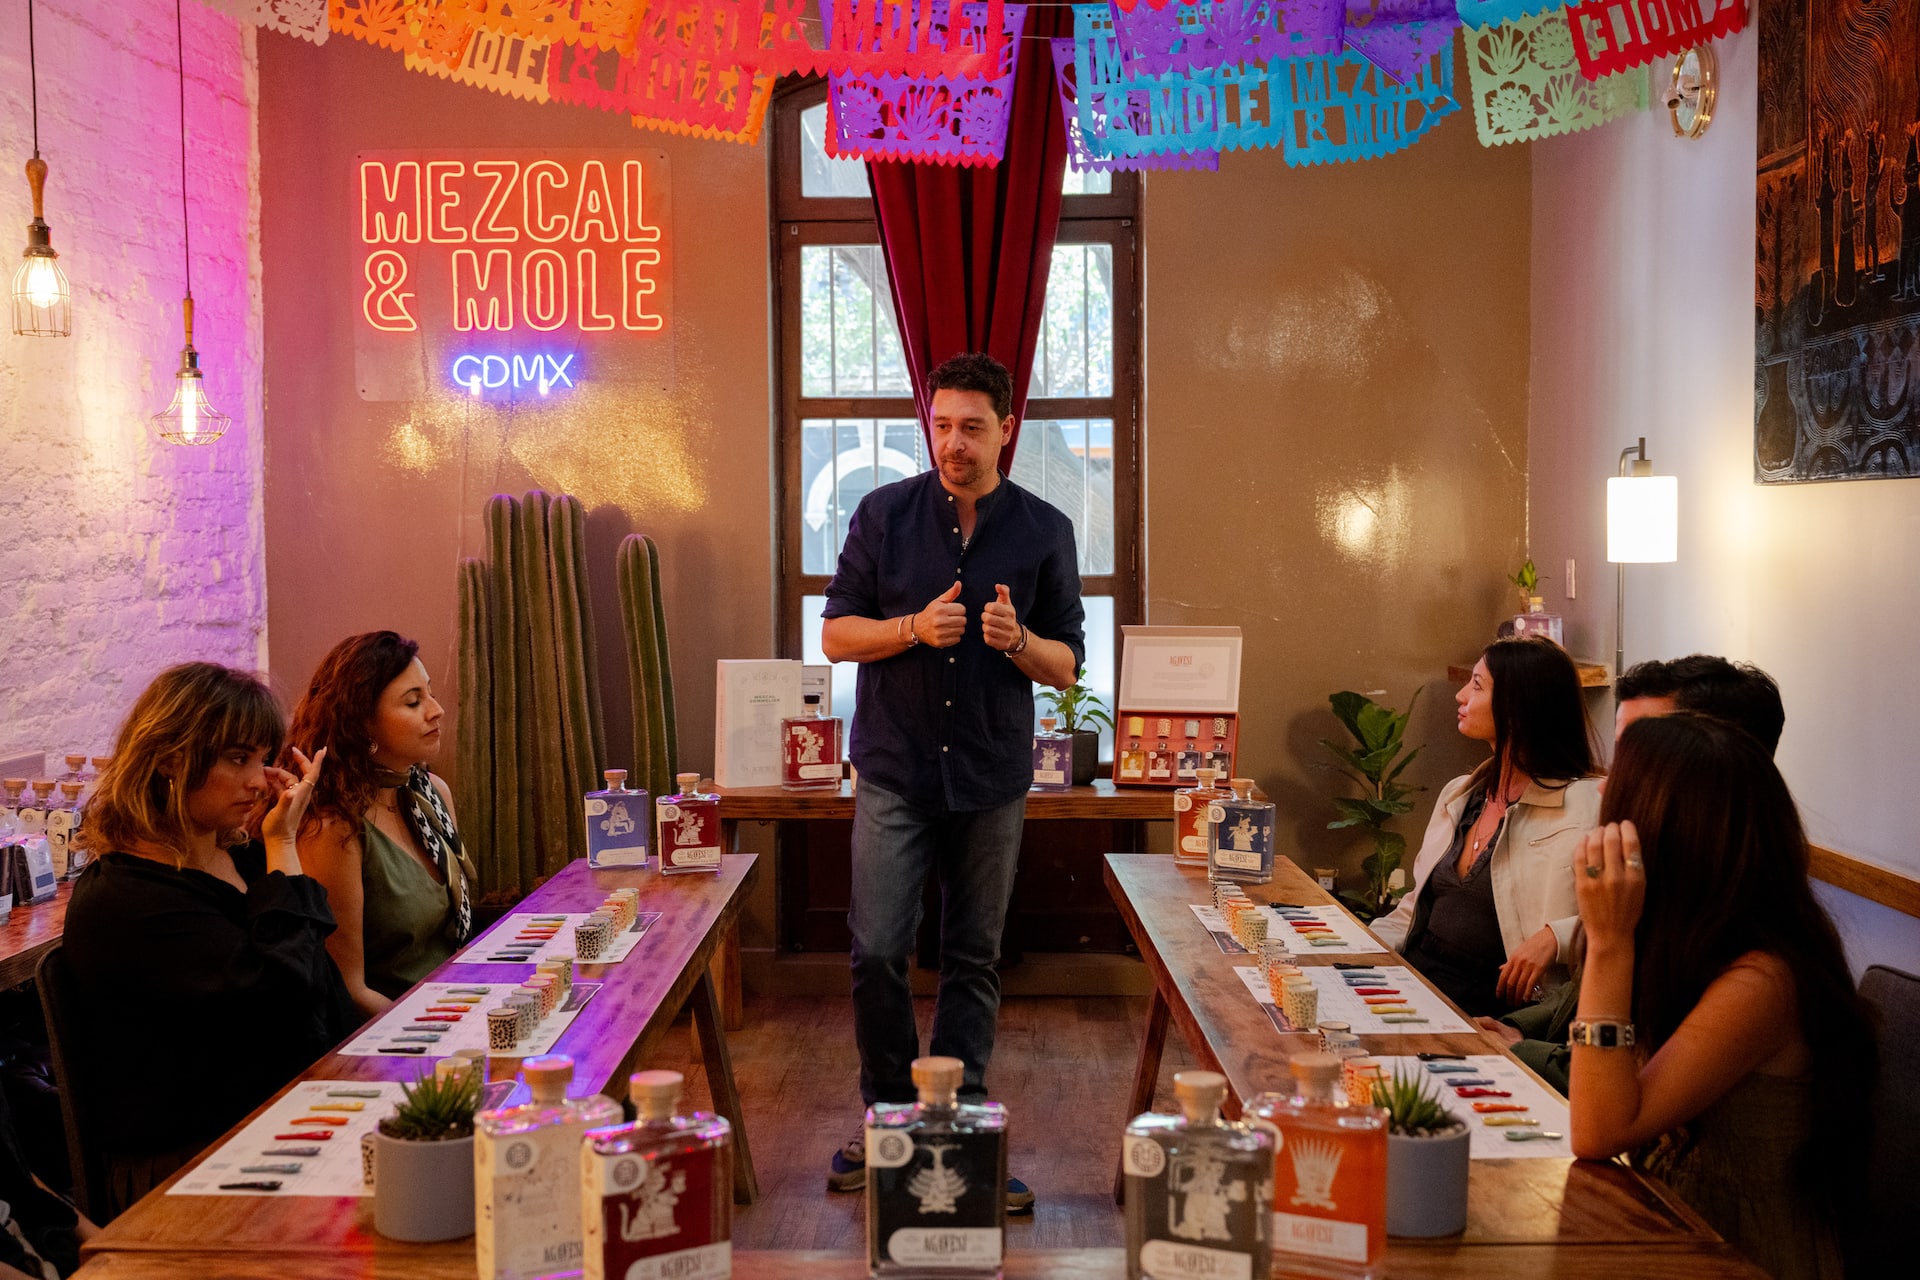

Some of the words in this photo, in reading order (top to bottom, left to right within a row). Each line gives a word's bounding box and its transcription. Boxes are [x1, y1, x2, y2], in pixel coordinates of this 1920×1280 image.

[831, 0, 974, 54] MOLE
[1104, 89, 1139, 136] &
[1150, 82, 1264, 136] MOLE
[1305, 108, 1336, 147] &
[1344, 101, 1420, 147] MOL
[361, 160, 660, 243] MEZCAL
[363, 250, 417, 331] &
[452, 249, 662, 331] MOLE
[453, 354, 574, 388] CDMX
